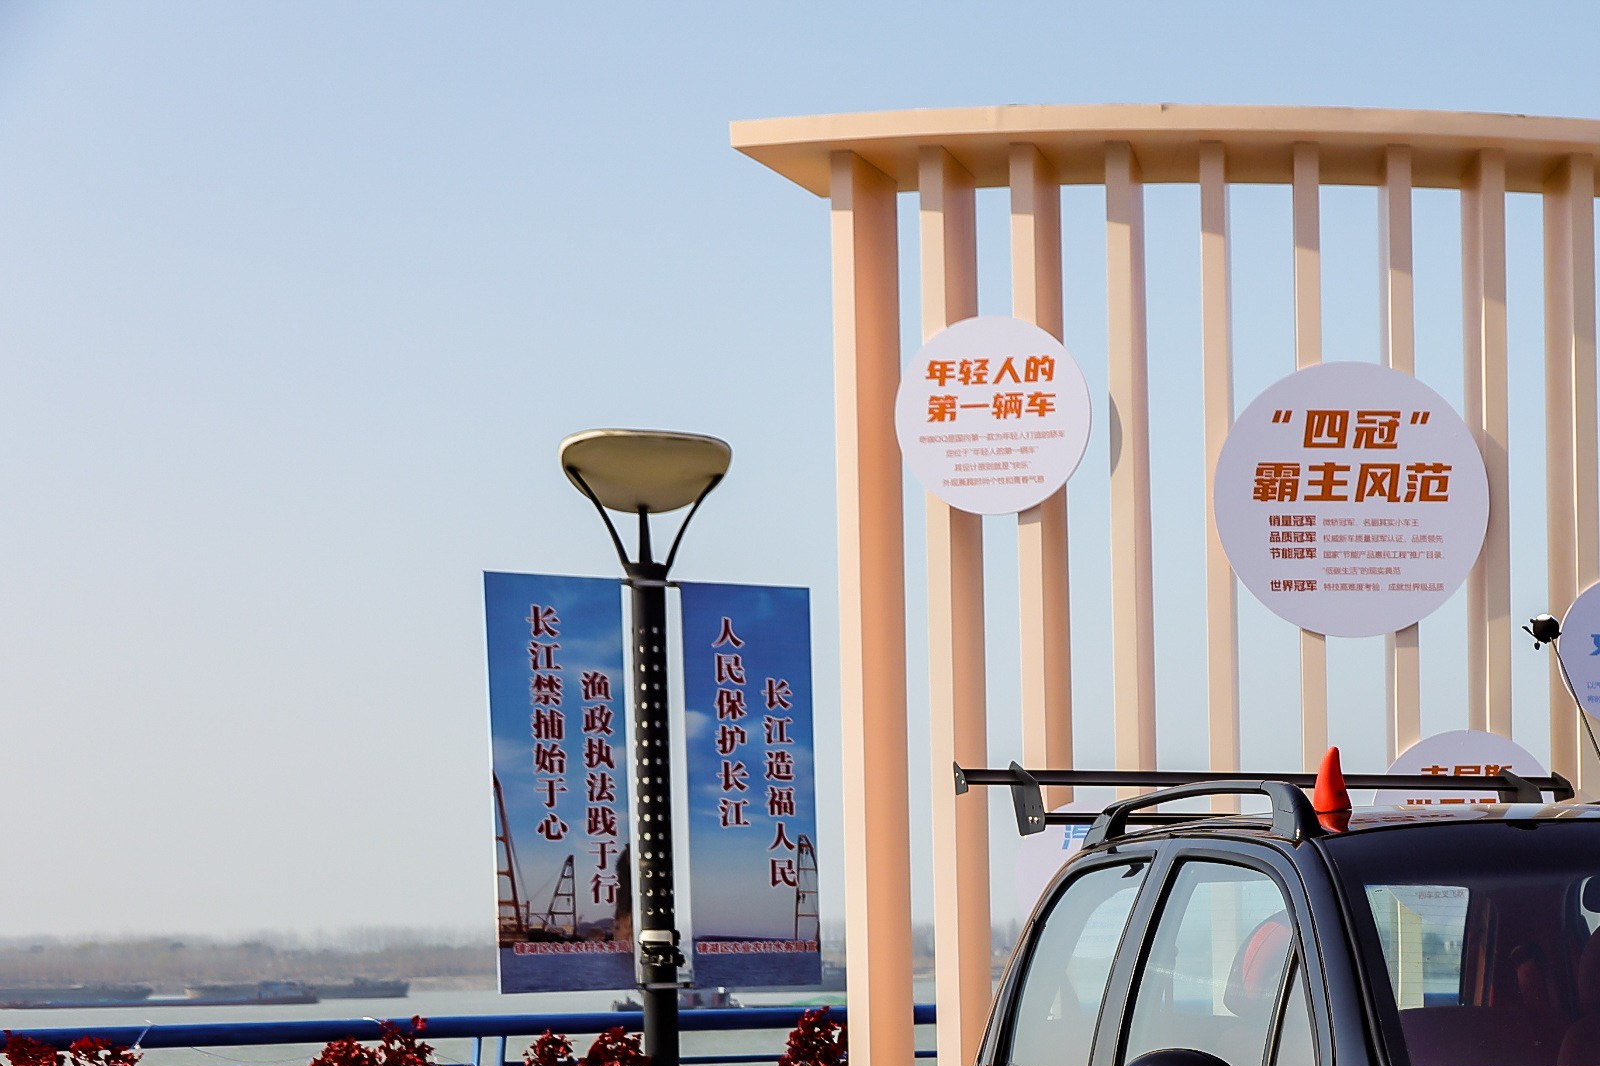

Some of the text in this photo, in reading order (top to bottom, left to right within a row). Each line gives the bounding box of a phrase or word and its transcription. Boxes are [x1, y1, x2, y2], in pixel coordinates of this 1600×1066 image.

[925, 355, 1055, 387] 年轻人的
[926, 391, 1056, 423] 第一辆车
[1272, 409, 1430, 449] “四冠”
[1252, 462, 1453, 503] 霸主风范
[1269, 515, 1317, 527] 销量冠军
[1269, 531, 1317, 543] 品质冠军
[1269, 547, 1317, 560] 节能冠军
[1270, 579, 1317, 592] 世界冠军
[525, 602, 570, 843] 长江禁捕始于心
[710, 616, 752, 829] 人民保护长江
[578, 669, 621, 906] 渔政执法践于行
[760, 677, 801, 889] 长江造福人民
